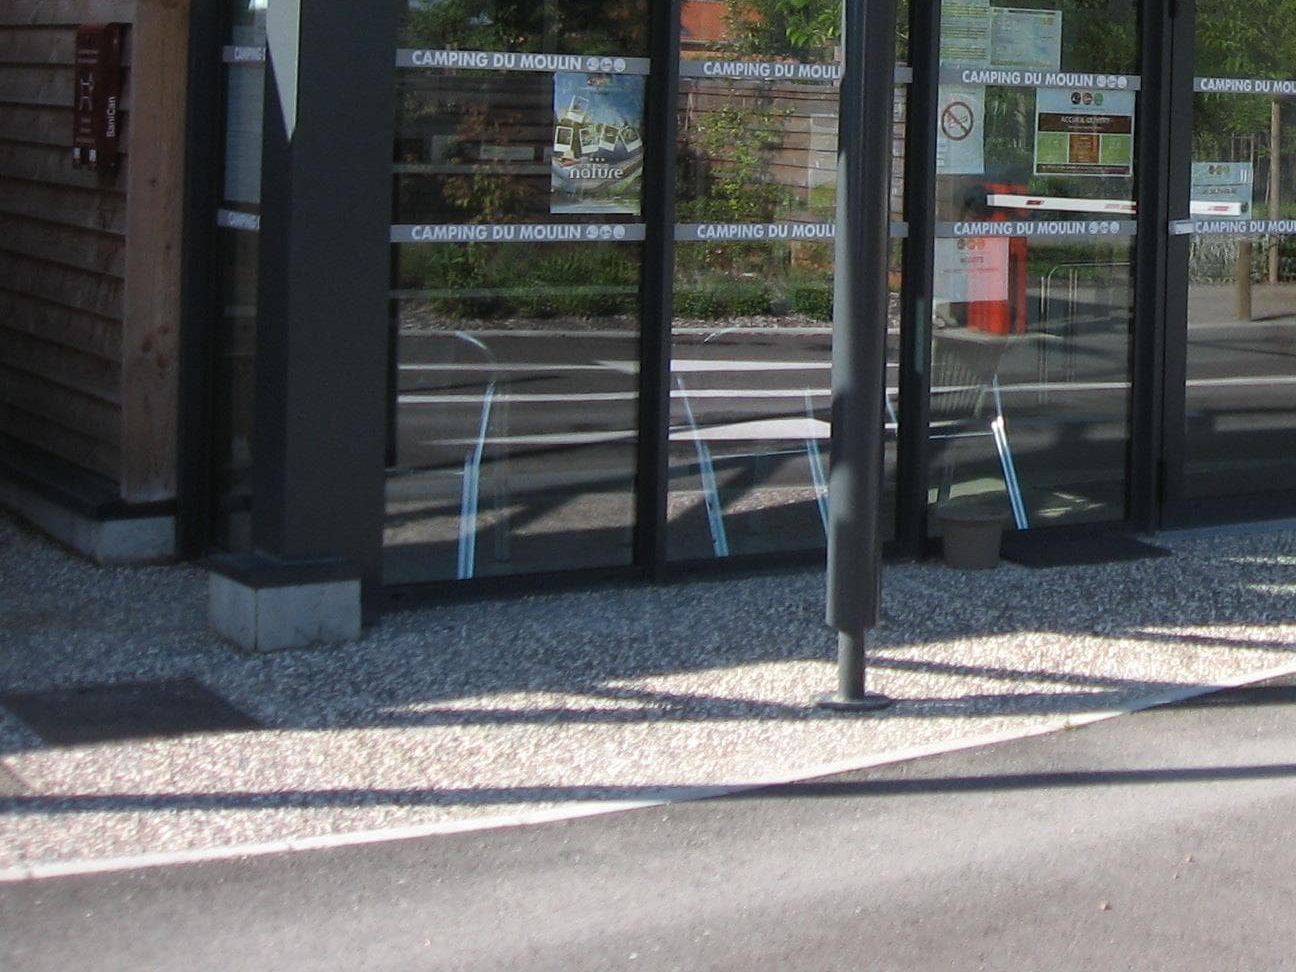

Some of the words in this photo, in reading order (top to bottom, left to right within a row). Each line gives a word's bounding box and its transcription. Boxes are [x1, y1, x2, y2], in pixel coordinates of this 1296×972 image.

[411, 50, 488, 67] CAMPING
[493, 53, 515, 68] DU
[519, 54, 582, 71] MOULIN
[703, 61, 770, 76] CAMPING
[775, 64, 794, 77] DU
[798, 65, 841, 79] MOULI
[962, 71, 1020, 84] CAMPING
[1024, 72, 1042, 85] DU
[1045, 73, 1093, 87] MOULIN
[1200, 78, 1251, 92] CAMPING
[1254, 80, 1270, 93] DU
[570, 166, 624, 179] nature
[411, 226, 488, 240] CAMPING
[492, 225, 515, 239] DU
[519, 225, 581, 240] MOULIN
[697, 224, 764, 238] CAMPING
[768, 224, 788, 238] DU
[791, 224, 836, 238] MOULI
[953, 222, 1012, 235] CAMPING
[1016, 222, 1034, 235] DU
[1037, 221, 1085, 234] MOULIN
[1195, 220, 1247, 234] CAMPING
[1250, 220, 1265, 233] DU
